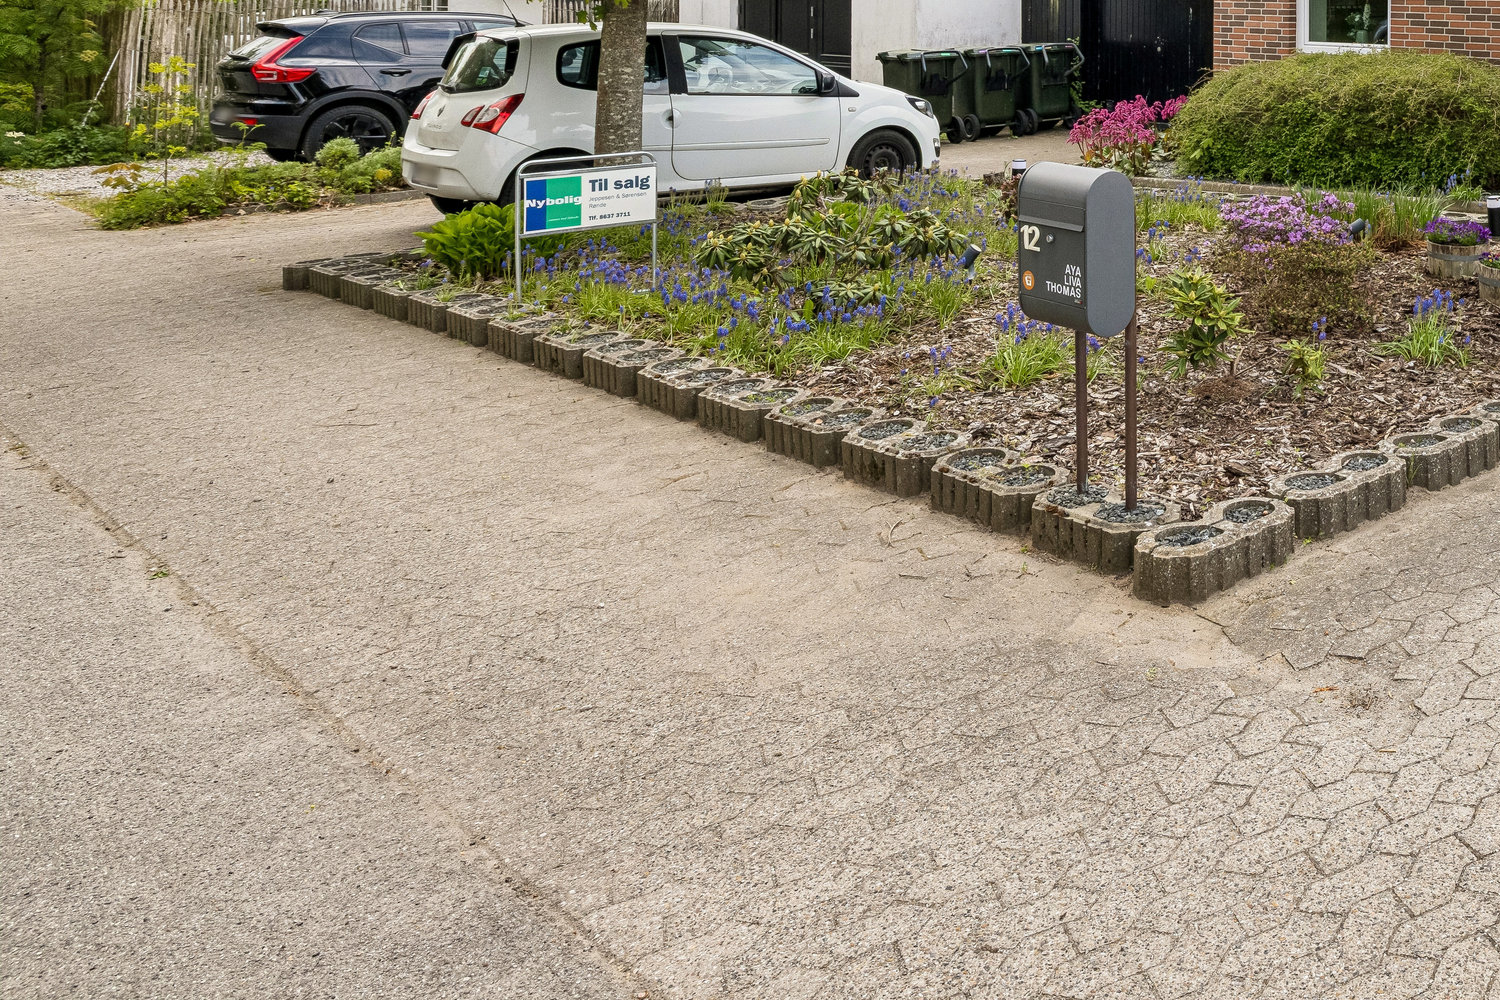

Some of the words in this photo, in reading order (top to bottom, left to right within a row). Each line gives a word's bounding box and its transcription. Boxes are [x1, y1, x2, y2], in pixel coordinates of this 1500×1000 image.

[589, 178, 608, 192] Til
[613, 175, 650, 190] salg
[525, 195, 582, 209] Nybolig
[589, 194, 615, 202] Jeppesen
[1020, 224, 1041, 252] 12
[1065, 264, 1082, 277] AYA
[1064, 275, 1082, 288] LIVA
[1046, 280, 1082, 299] THOMAS
